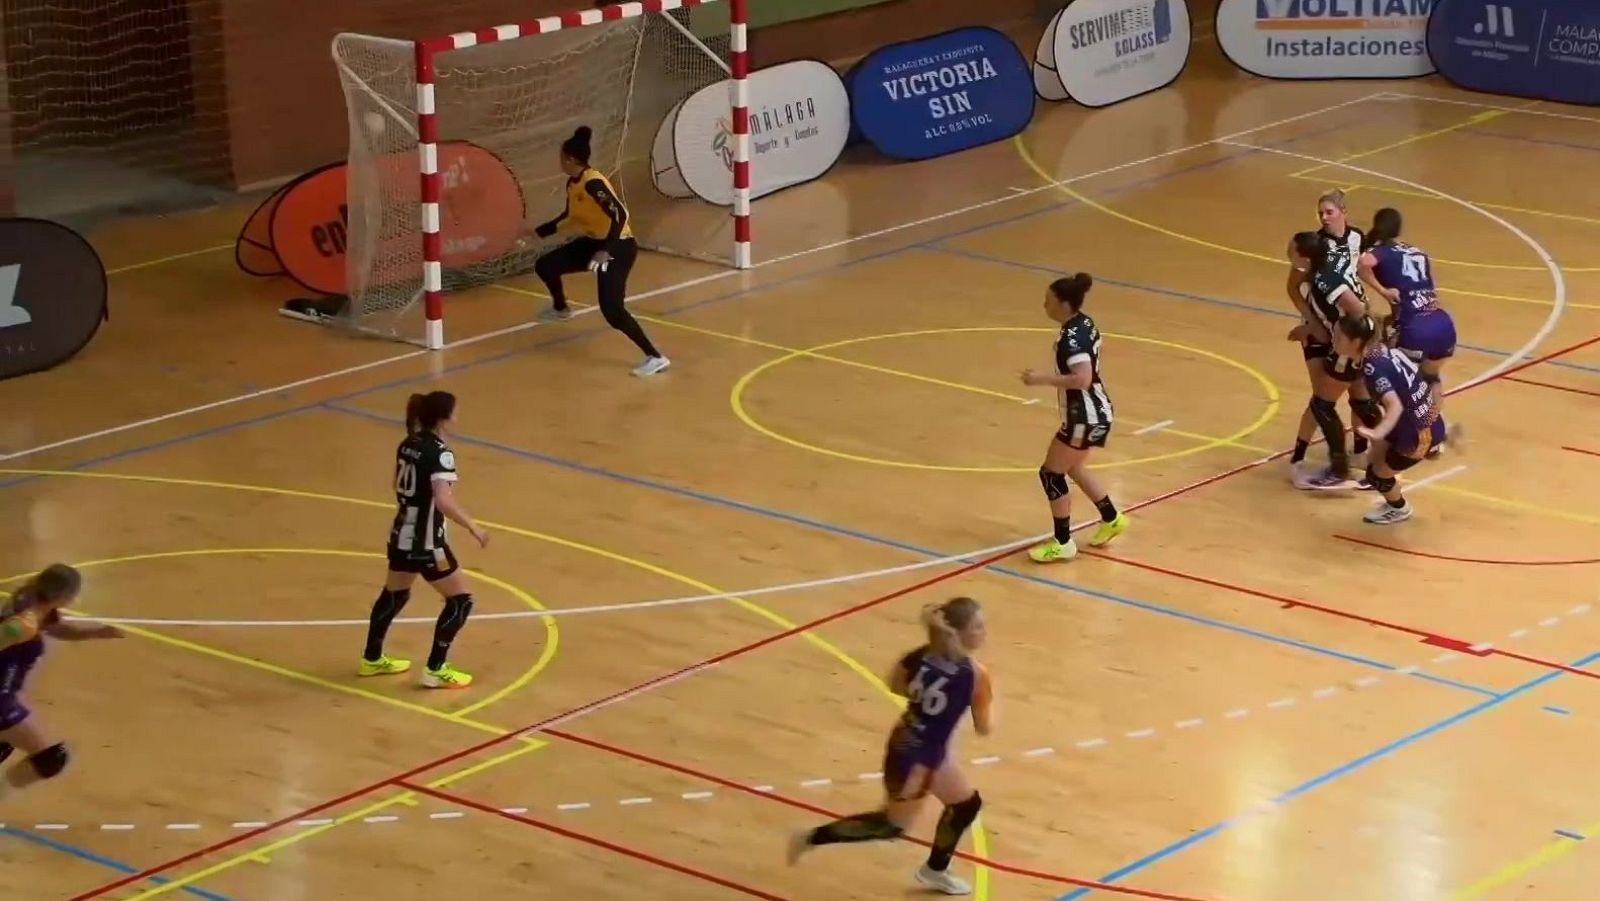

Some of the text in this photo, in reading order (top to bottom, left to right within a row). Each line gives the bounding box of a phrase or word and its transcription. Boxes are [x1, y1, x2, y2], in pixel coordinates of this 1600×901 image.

[1556, 25, 1600, 41] MALA
[1267, 37, 1425, 58] Instalaciones
[1549, 38, 1600, 57] COMP
[882, 57, 998, 101] VICTORIA
[749, 97, 815, 136] MÁLAGA
[928, 91, 973, 119] SIN
[925, 125, 947, 139] ALC
[971, 113, 993, 127] VOL
[1402, 253, 1426, 282] 47
[396, 459, 417, 498] 20
